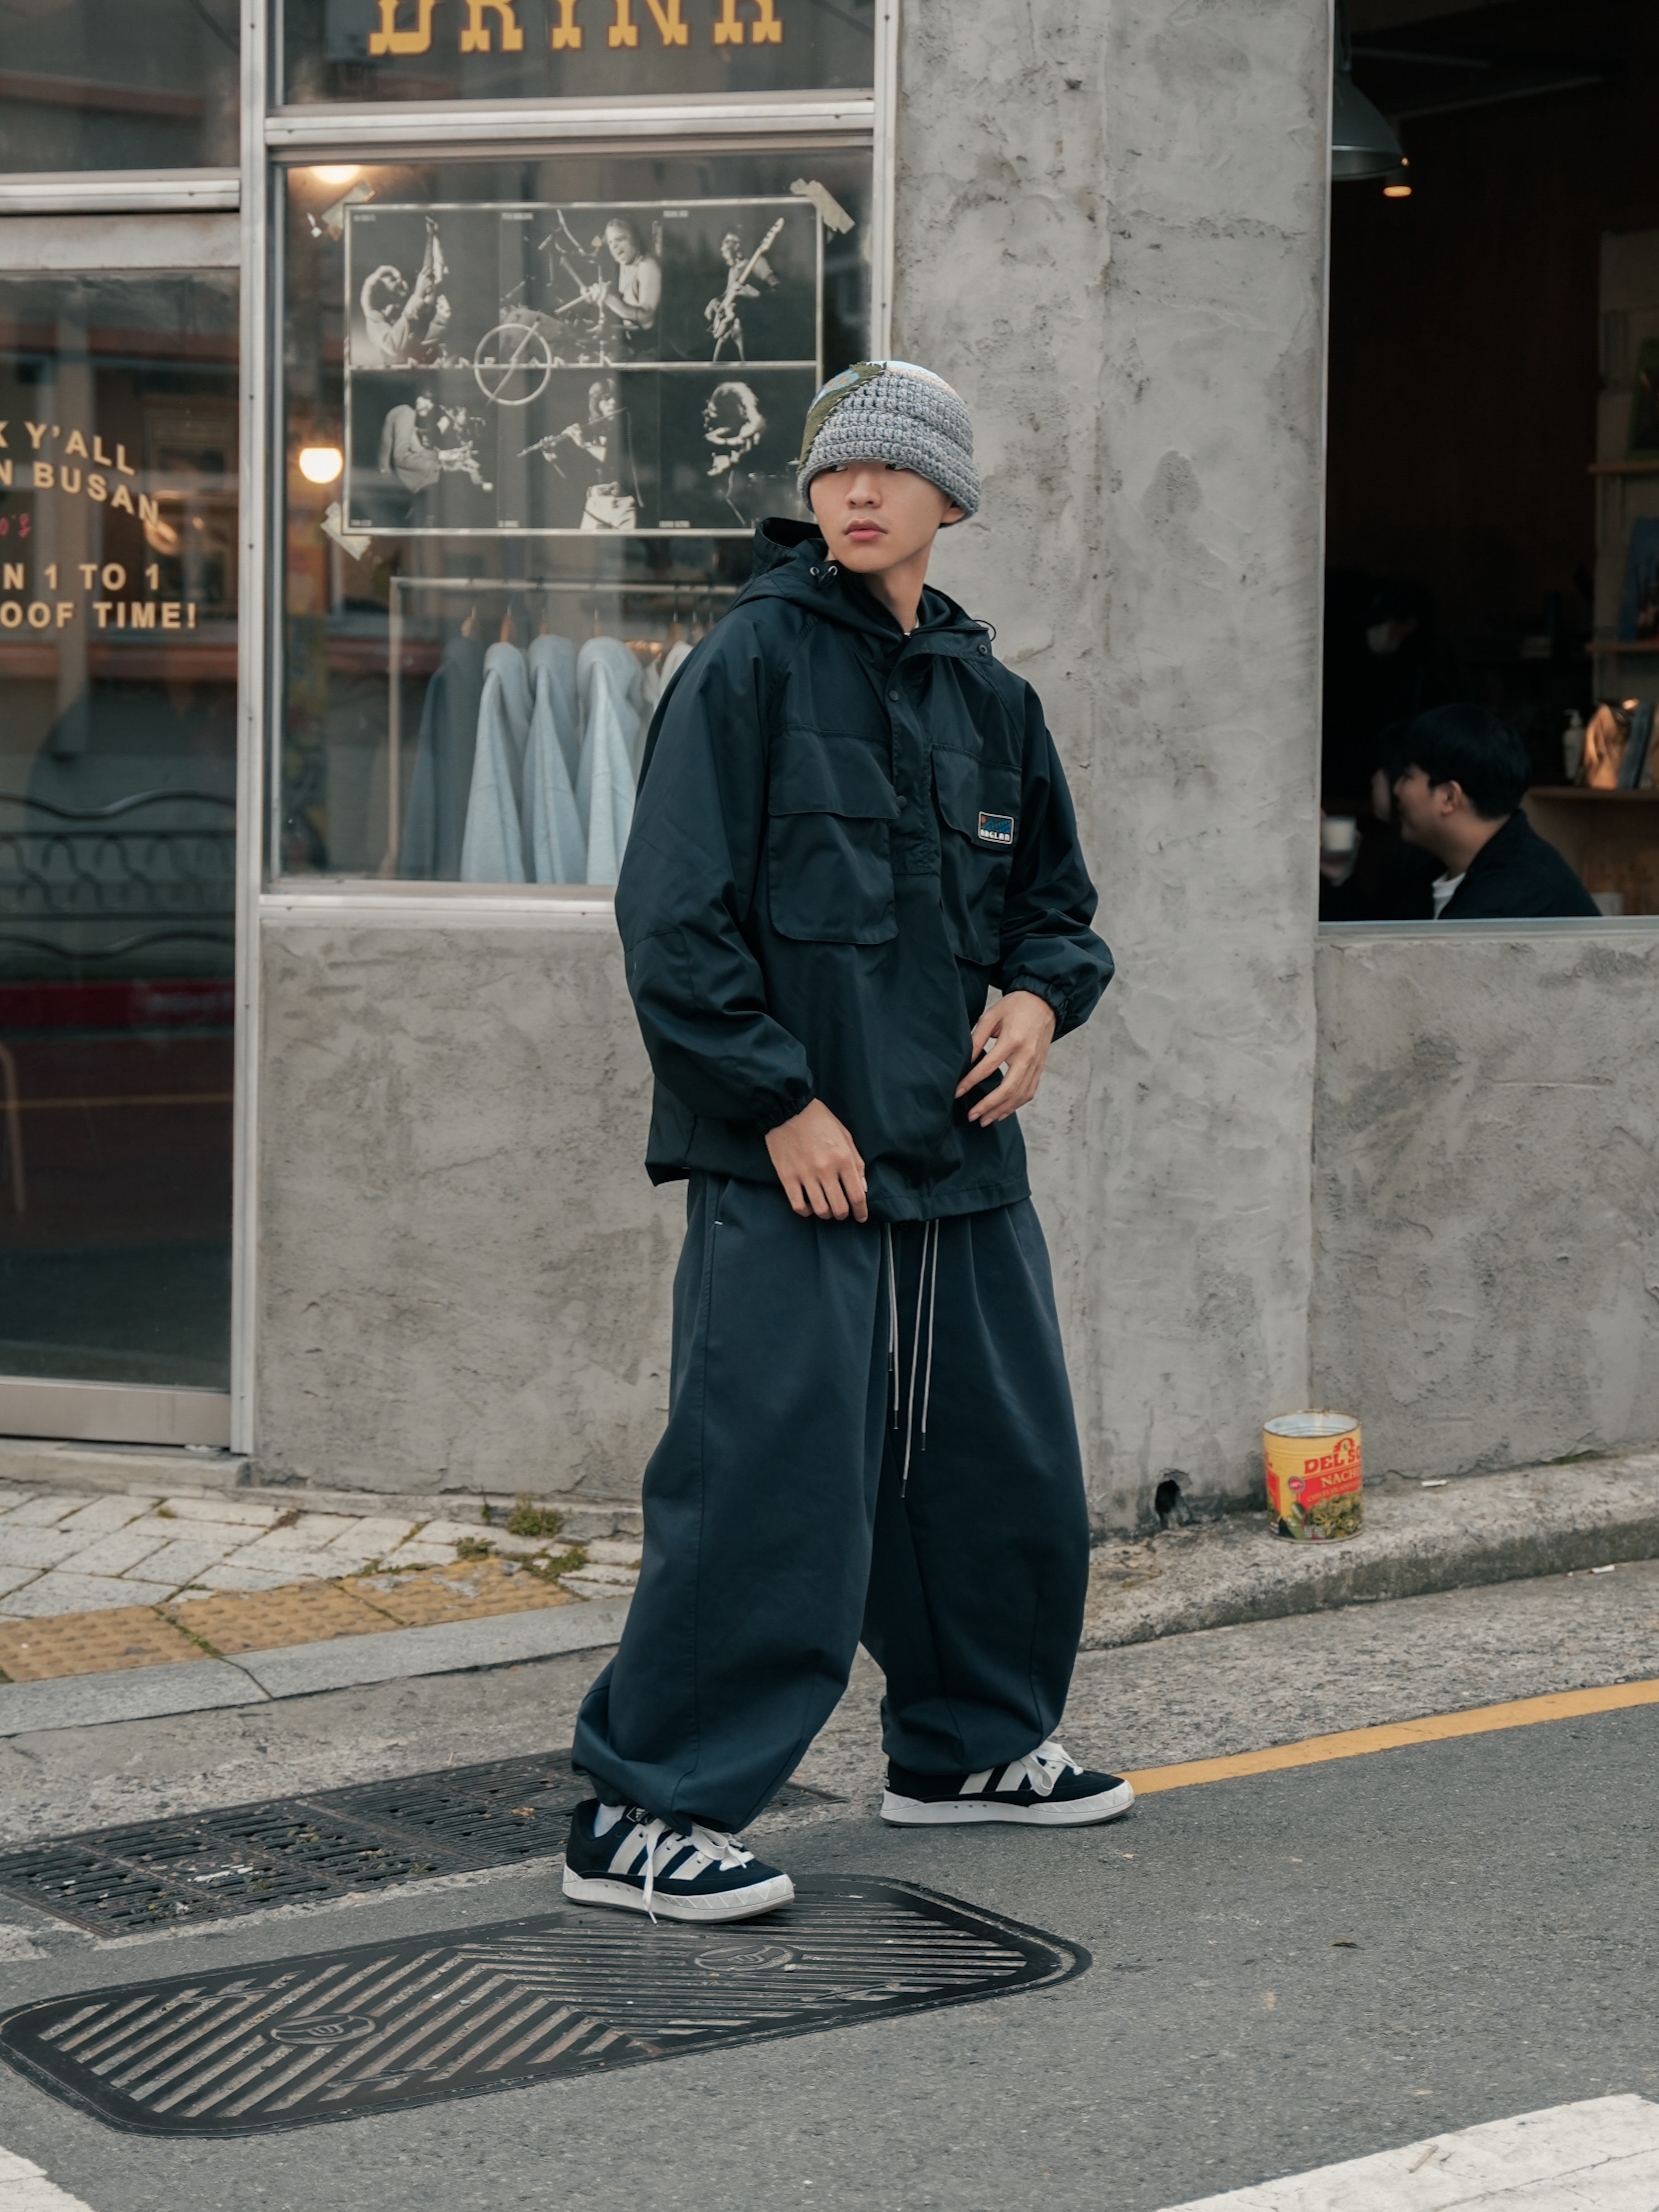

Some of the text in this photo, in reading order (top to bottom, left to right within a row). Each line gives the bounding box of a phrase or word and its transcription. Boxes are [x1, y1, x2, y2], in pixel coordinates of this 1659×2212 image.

[24, 421, 135, 476] Y'ALL
[33, 461, 159, 526] BUSAN
[44, 563, 58, 590] 1
[79, 563, 127, 591] TO
[145, 563, 159, 591] 1
[92, 602, 196, 629] TIME!
